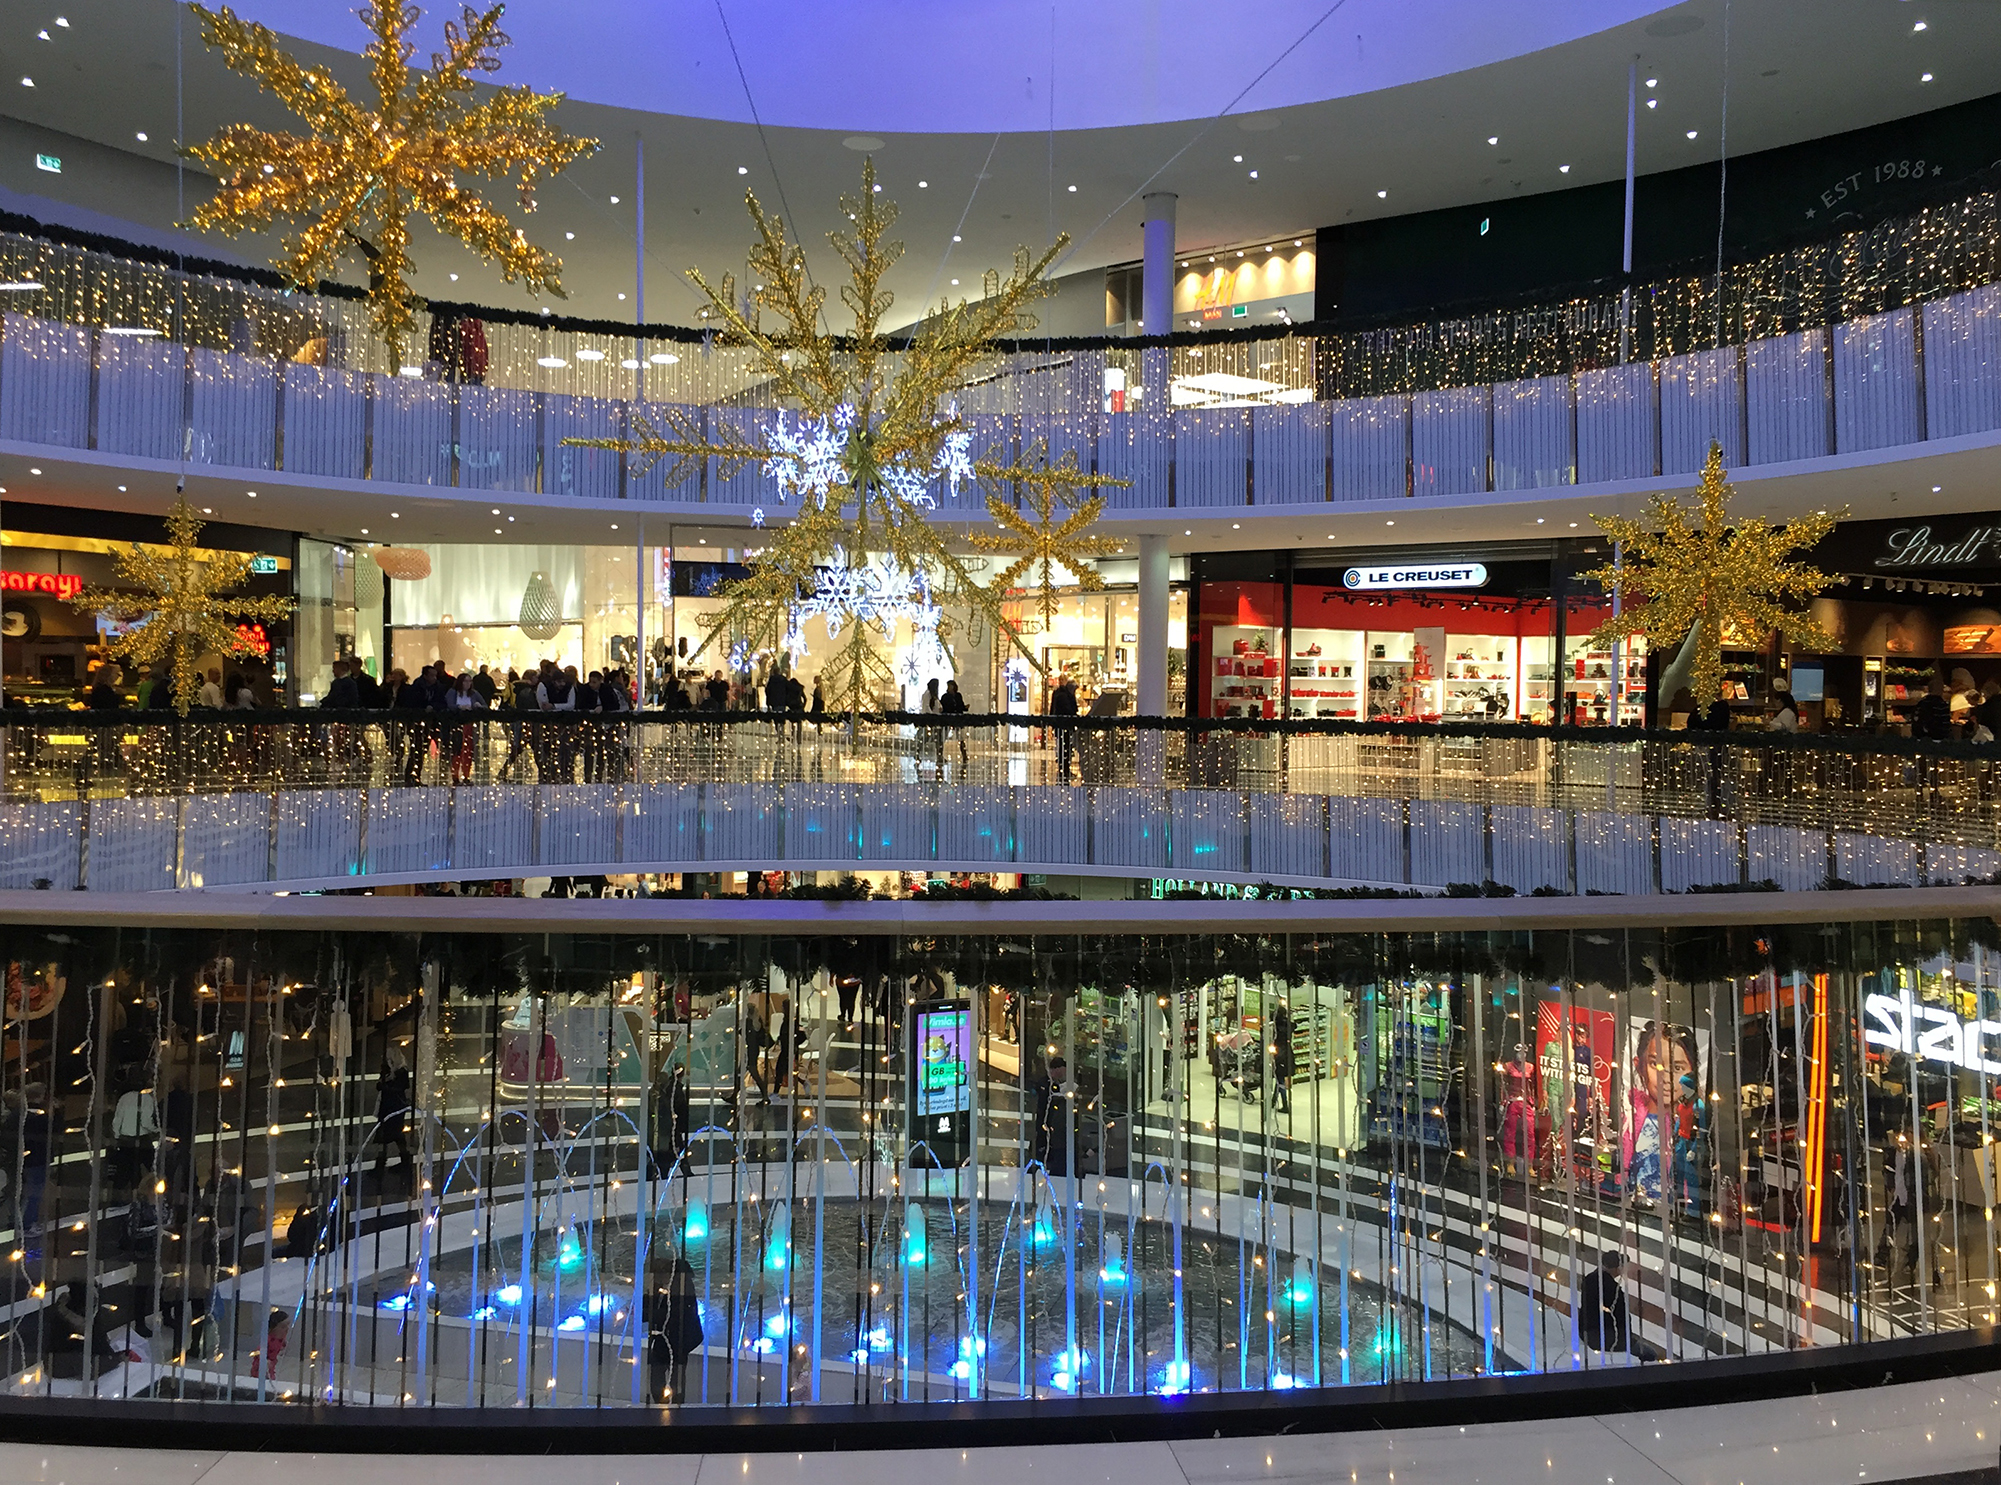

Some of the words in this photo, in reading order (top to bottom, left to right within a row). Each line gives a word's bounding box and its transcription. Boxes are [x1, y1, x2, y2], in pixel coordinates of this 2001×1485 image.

[1820, 172, 1861, 209] EST
[1875, 160, 1926, 183] 1988
[1438, 312, 1508, 349] SPORTS
[1514, 298, 1642, 340] RESTAURANT
[1874, 526, 1989, 567] Lindt
[1369, 573, 1389, 583] LE
[1393, 570, 1473, 582] CREUSET
[1151, 878, 1239, 901] HOLLAND
[931, 1067, 945, 1076] GB
[1539, 1055, 1549, 1066] IT
[1550, 1057, 1589, 1075] STRTS
